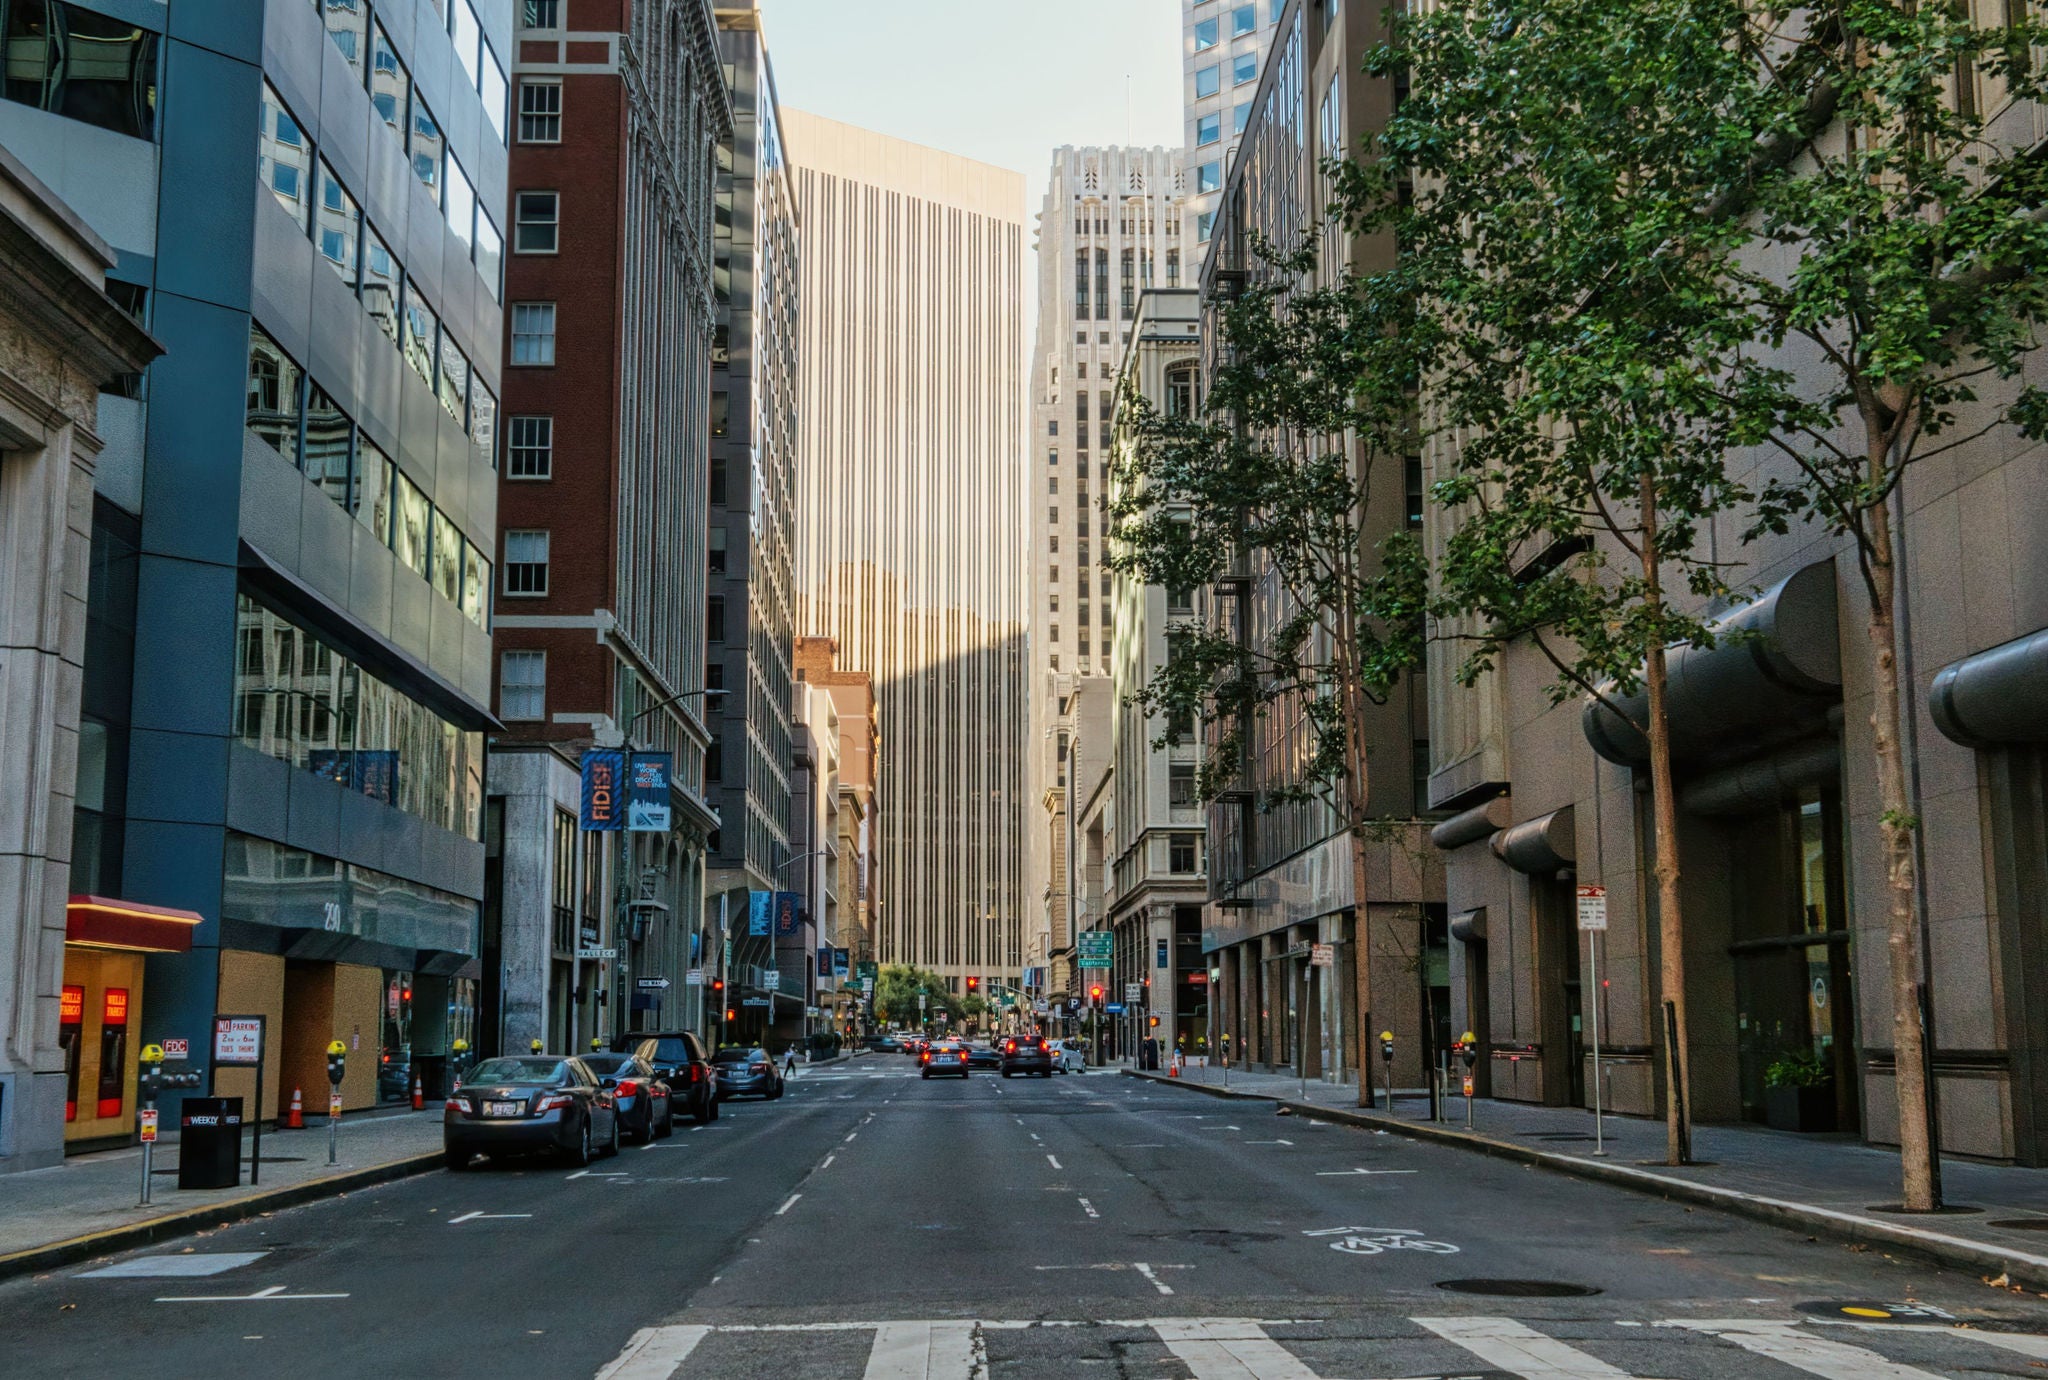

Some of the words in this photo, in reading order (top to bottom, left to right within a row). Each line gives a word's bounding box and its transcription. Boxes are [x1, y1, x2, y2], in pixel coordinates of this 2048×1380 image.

[325, 902, 340, 932] 290
[1070, 999, 1079, 1009] P
[218, 1020, 231, 1032] NO
[232, 1022, 259, 1032] PARKING
[165, 1041, 186, 1051] FDC
[190, 1116, 219, 1125] WEEKLY
